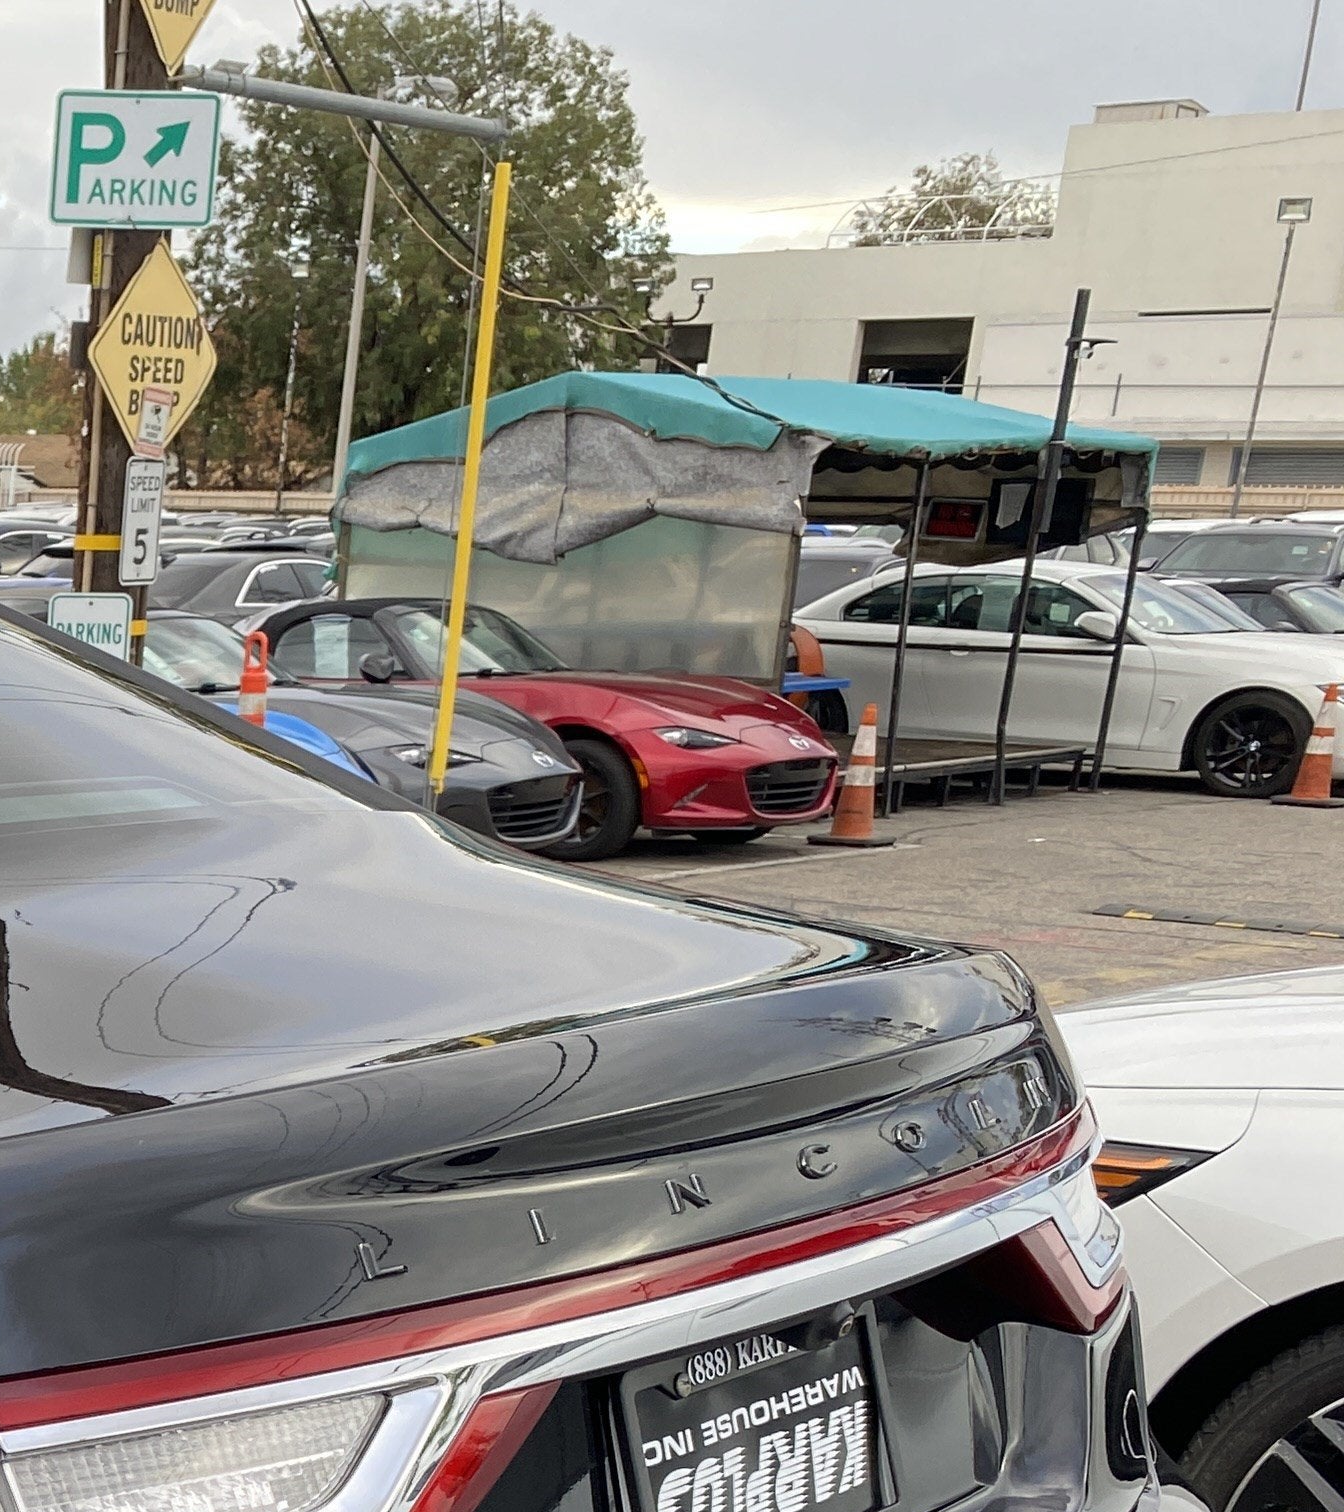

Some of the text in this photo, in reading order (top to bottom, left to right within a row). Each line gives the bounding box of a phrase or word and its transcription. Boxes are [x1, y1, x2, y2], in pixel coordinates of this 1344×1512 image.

[66, 112, 198, 206] PARKING
[121, 313, 196, 350] CAUTION
[129, 355, 185, 384] SPEED
[128, 389, 180, 416] BP
[130, 476, 161, 491] SPEED
[131, 498, 156, 513] LIMIT
[133, 528, 149, 565] 5
[353, 1073, 1053, 1283] LINCOLN
[687, 1346, 732, 1386] (888)
[703, 1366, 865, 1447] WAREHOUSE
